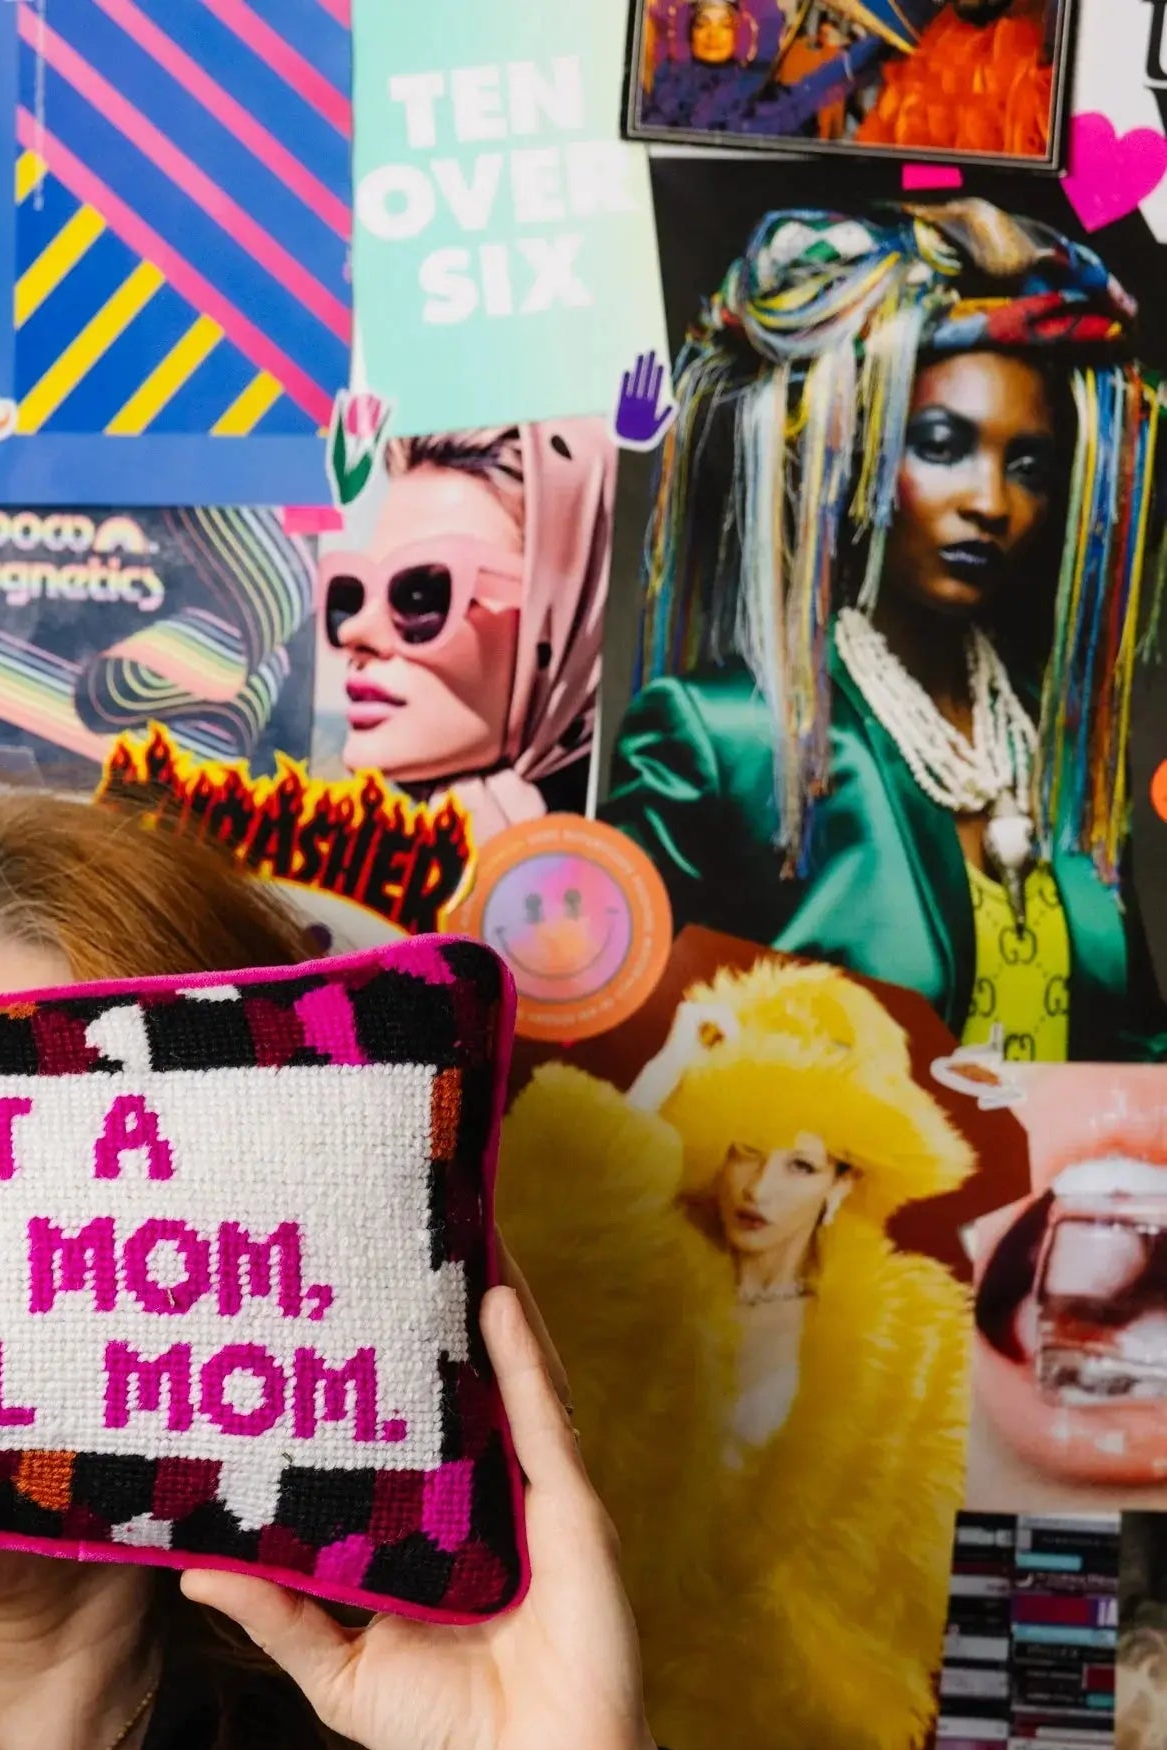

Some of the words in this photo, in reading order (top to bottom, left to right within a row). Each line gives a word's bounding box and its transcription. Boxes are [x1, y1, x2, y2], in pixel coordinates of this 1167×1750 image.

[389, 55, 583, 149] TEN
[356, 139, 643, 241] OVER
[418, 233, 596, 326] SIX
[93, 1094, 175, 1182] A
[26, 1216, 334, 1321] MOM,
[103, 1339, 408, 1443] MOM.
